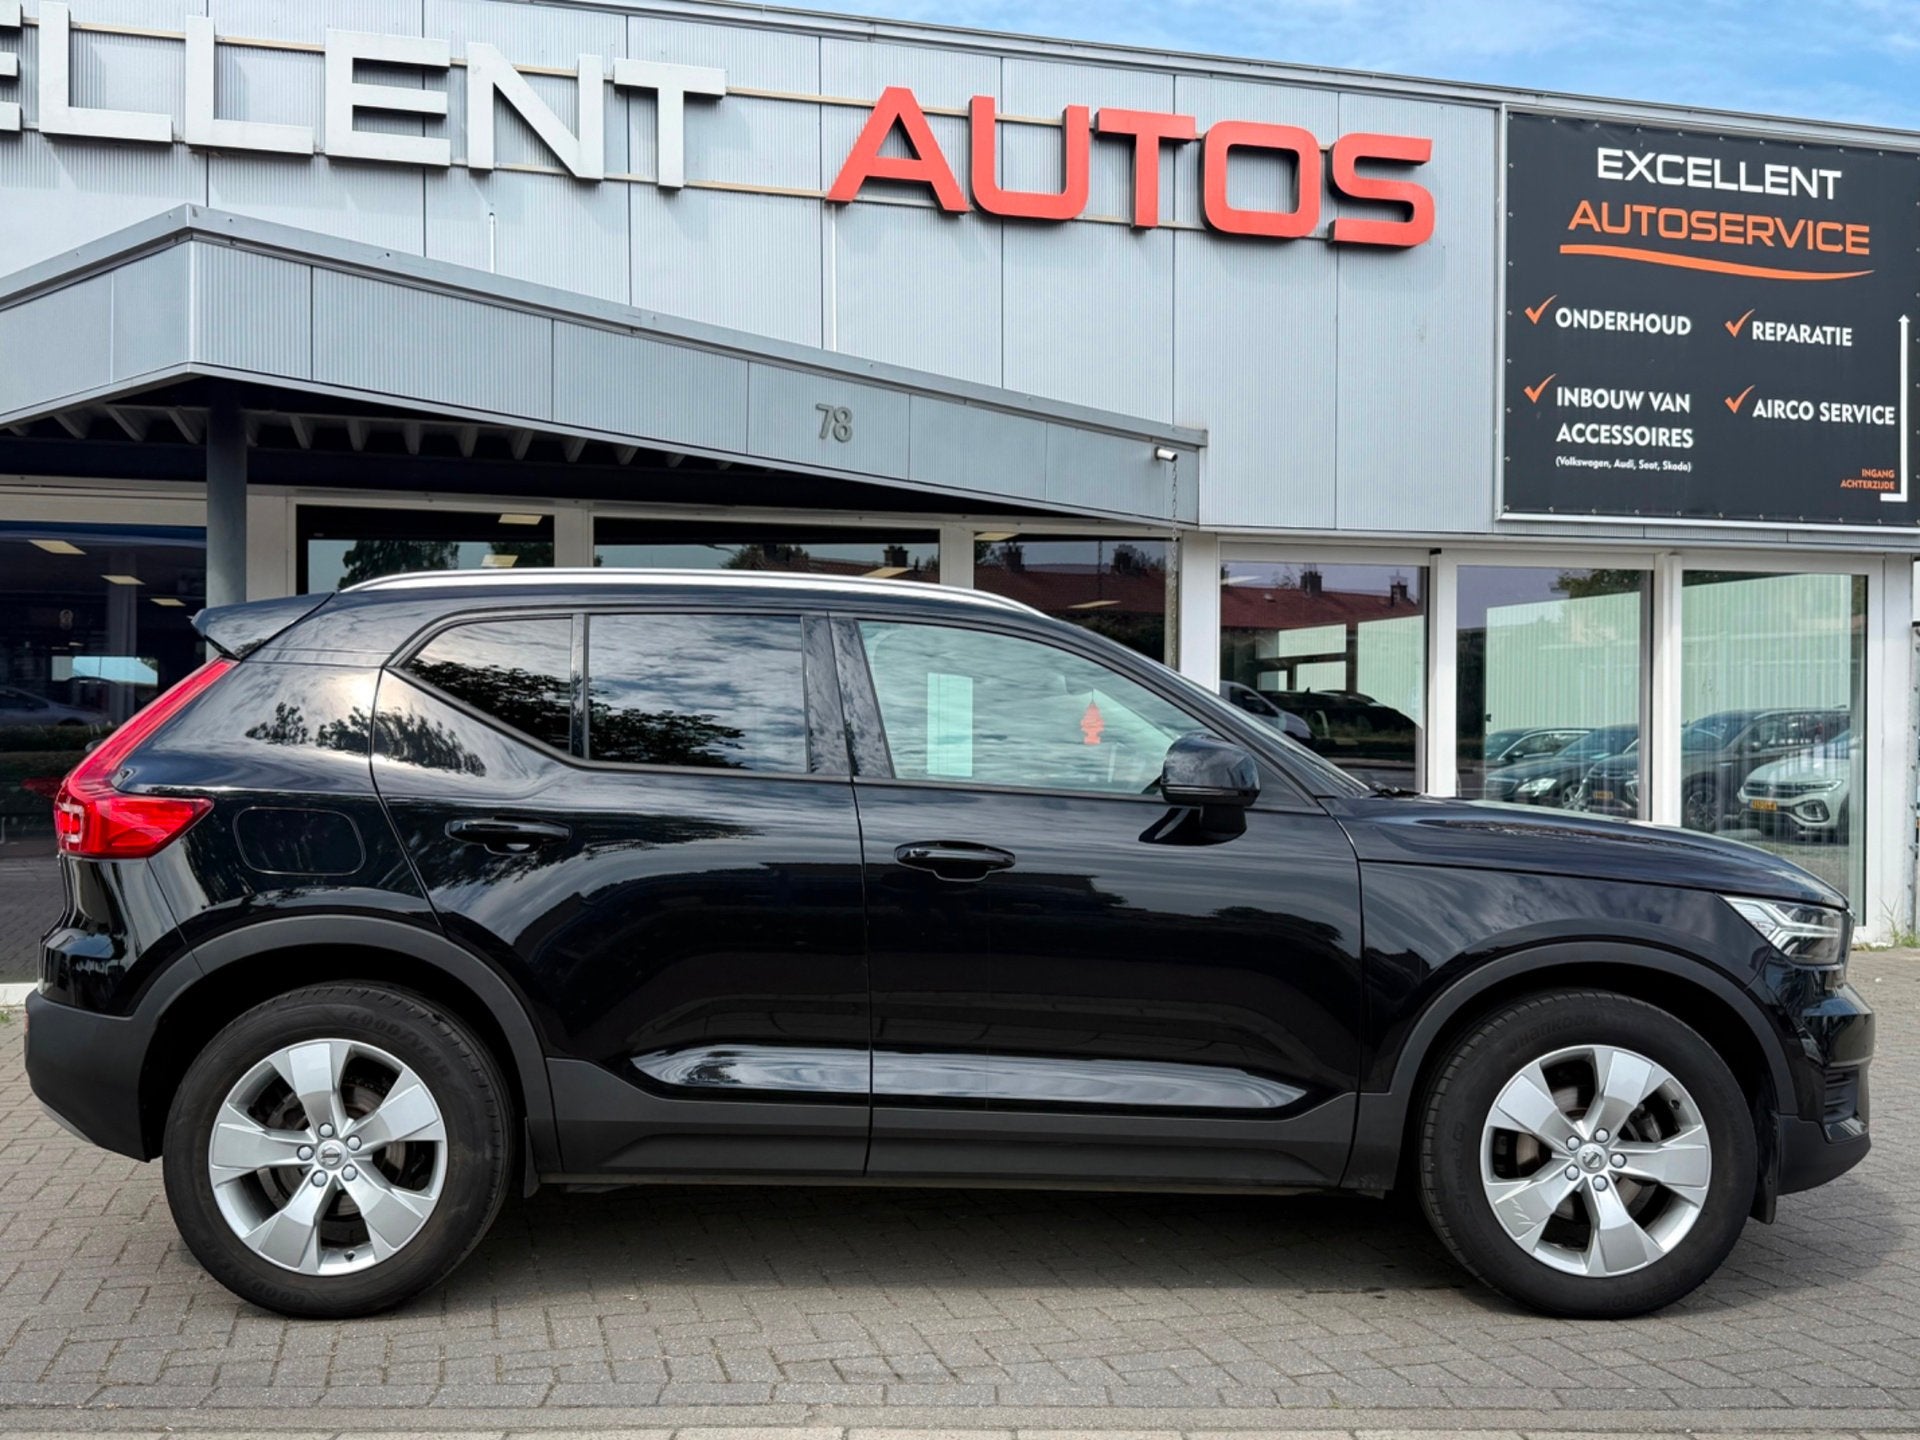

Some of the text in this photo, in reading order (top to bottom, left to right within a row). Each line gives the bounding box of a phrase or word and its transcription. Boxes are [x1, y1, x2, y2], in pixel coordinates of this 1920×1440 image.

[0, 1, 1436, 247] LLENT AUTOS
[1597, 147, 1842, 200] EXCELLENT
[1568, 200, 1870, 255] AUTOSERVICE
[1555, 307, 1692, 336] ONDERHOUD
[1752, 320, 1853, 347] REPARATIE
[1556, 386, 1691, 414] INBOUW VAN
[1752, 399, 1896, 426] AIRCO SERVICE
[814, 402, 853, 443] 78
[1556, 422, 1694, 449] ACCESSOIRES
[1555, 455, 1692, 473] (Volkswagen, Audi, Seat, Skoda)
[1861, 468, 1896, 479] INGANG
[1840, 479, 1896, 491] ACHTERZIJDE
[346, 1011, 452, 1077] GOODYEAR
